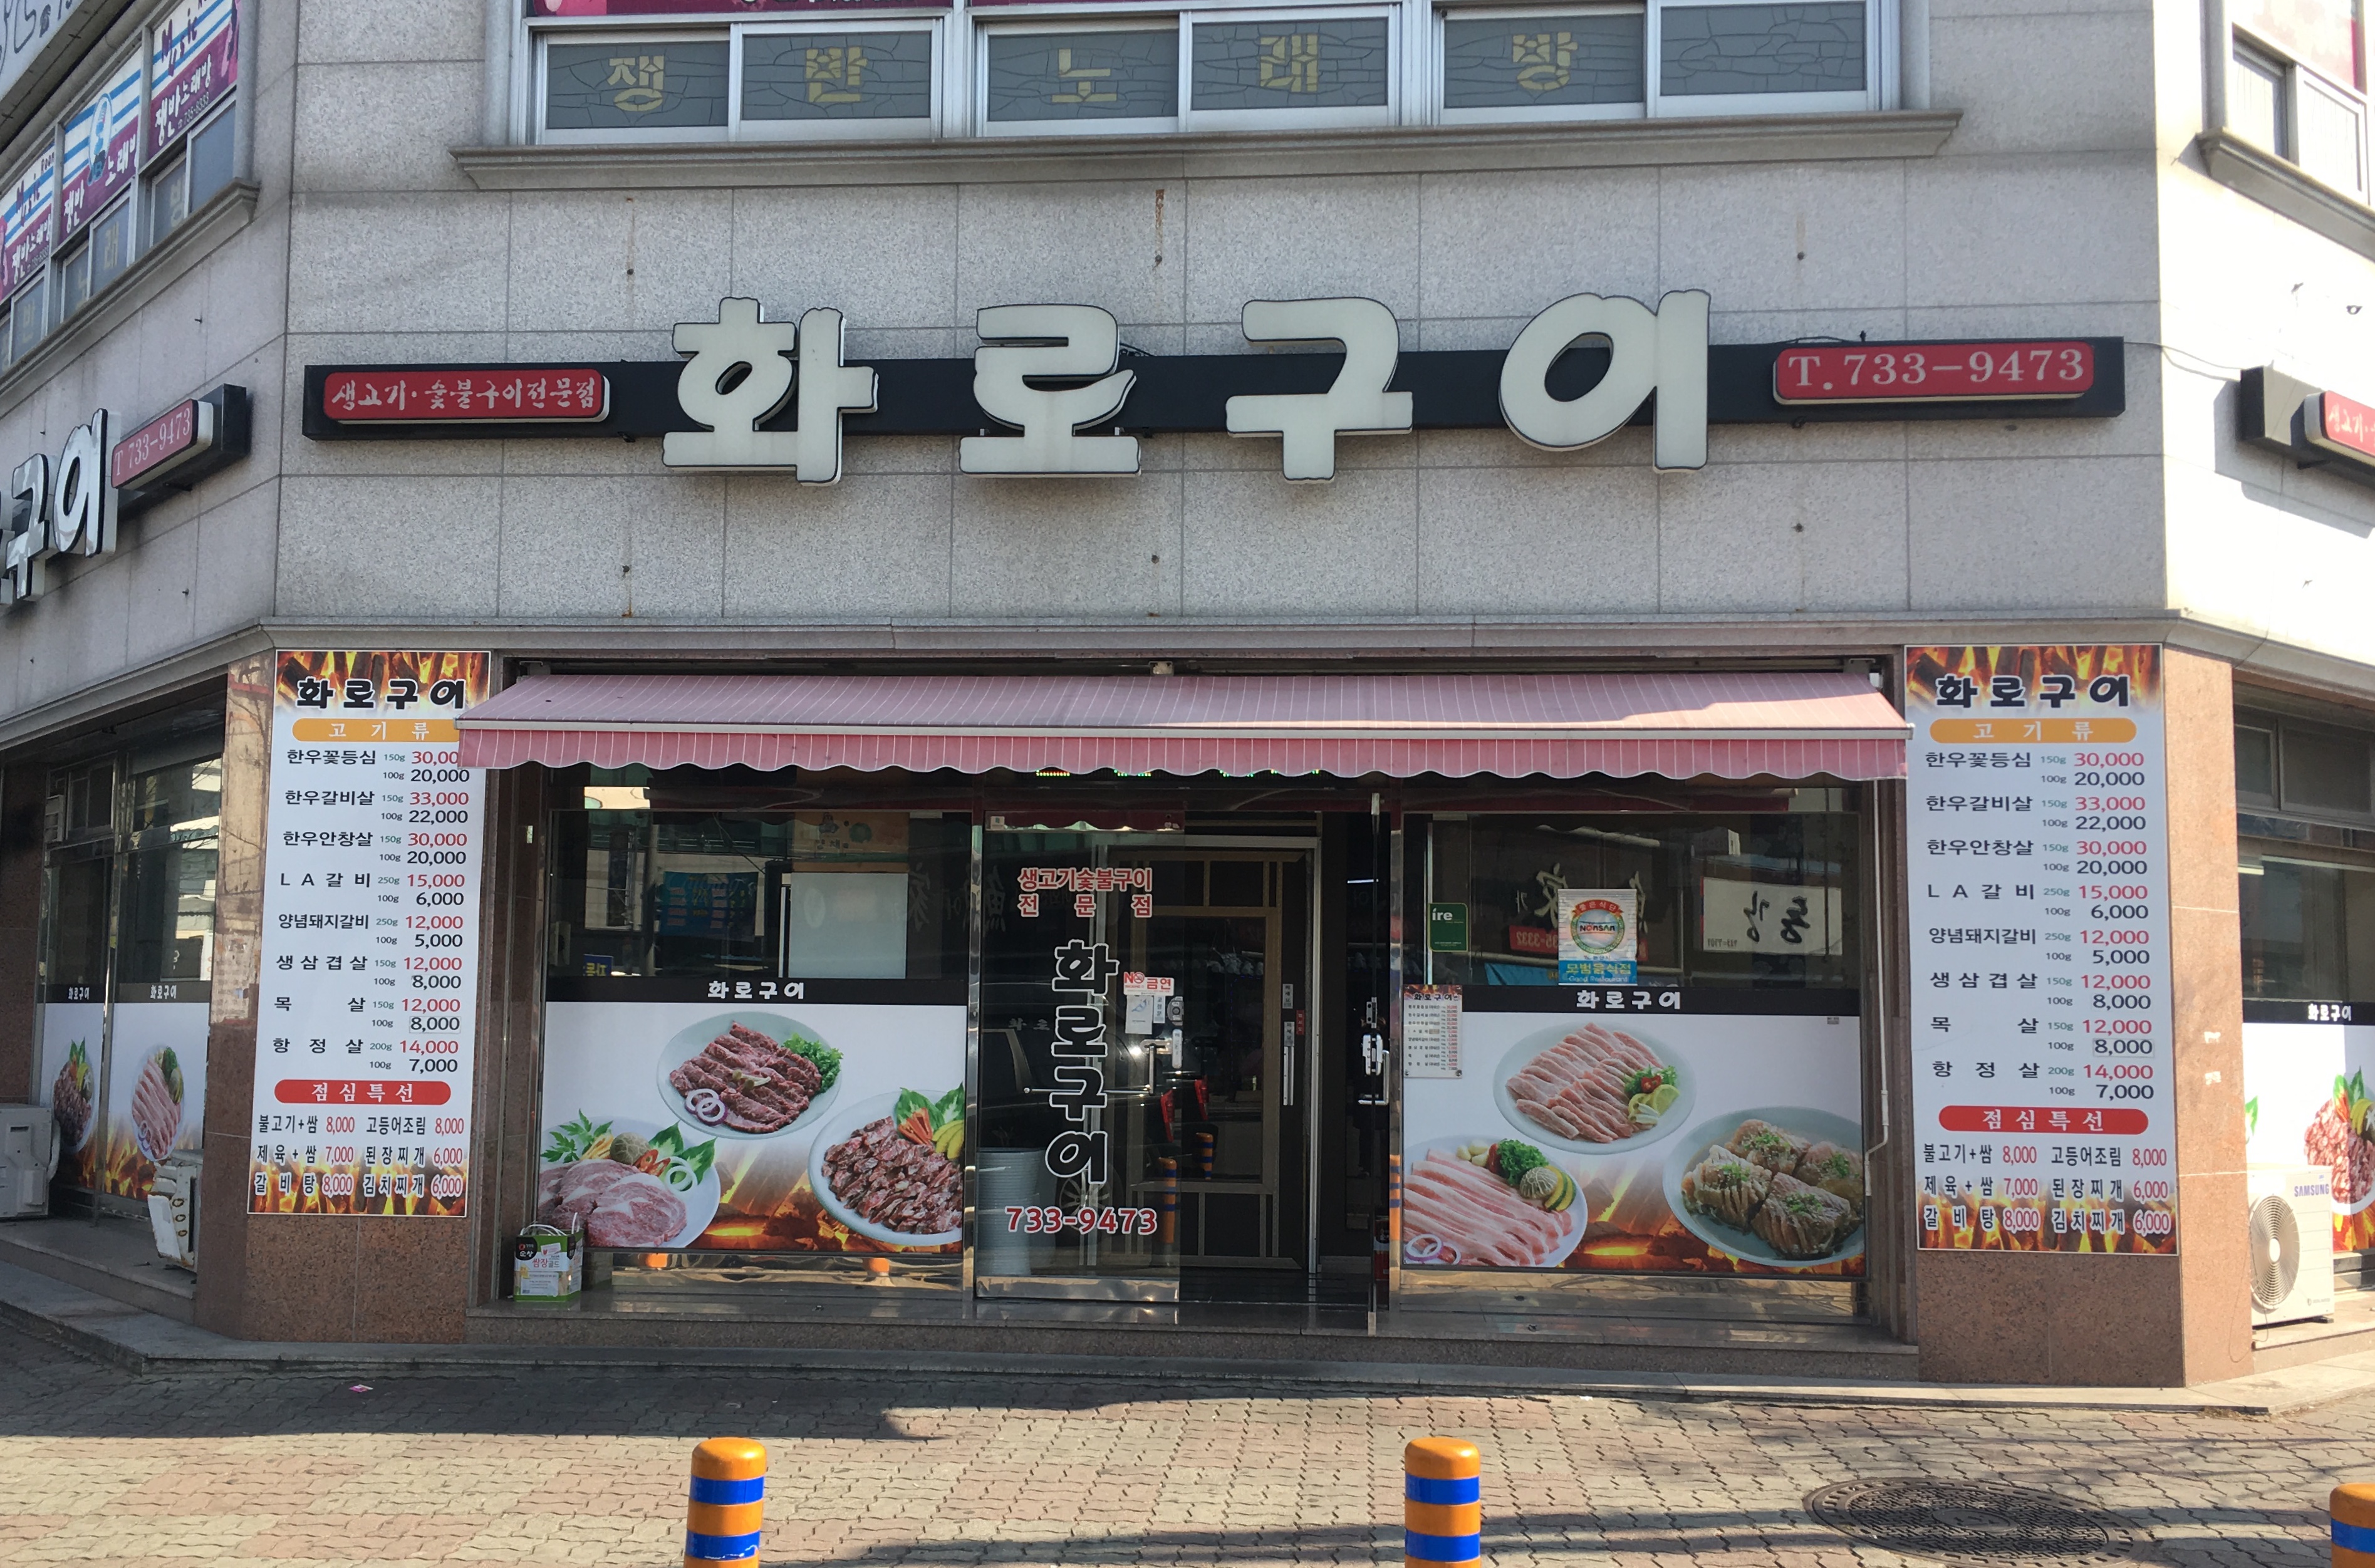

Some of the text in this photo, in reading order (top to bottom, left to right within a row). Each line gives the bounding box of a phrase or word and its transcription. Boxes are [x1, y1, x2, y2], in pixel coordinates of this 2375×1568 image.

[661, 294, 1712, 485] 화로구이
[296, 678, 465, 709] 화로구이
[1936, 676, 2129, 708] 화로구이
[288, 750, 375, 764] 한우꽃등심
[411, 751, 459, 766] 30,00
[1926, 752, 2144, 768] 한우꽃등심 150g 30,000
[383, 769, 469, 784] 100g 20,000
[2042, 772, 2144, 787] 100g 20,000
[286, 791, 375, 805] 한우갈비살
[410, 792, 469, 807] 33,000
[1926, 796, 2145, 812] 한우갈비살 150g 33,000
[409, 810, 468, 824] 22,000
[2042, 816, 2146, 832] 100g 22,000
[284, 831, 373, 846] 한우안창살
[408, 833, 467, 848] 30,000
[1927, 840, 2146, 856] 한우안창살 150g 30,000
[380, 851, 466, 866] 100g 20,000
[2044, 861, 2147, 876] 100g 20,000
[408, 875, 464, 889] 15,000
[1018, 868, 1152, 891] 생고기숯불구이
[417, 892, 464, 907] 6,000
[2044, 888, 2070, 896] 250g
[2079, 886, 2148, 901] 15,000
[2045, 905, 2148, 921] 100g 6,000
[279, 914, 463, 930] 양념돼지갈비 250g 12,000
[377, 934, 462, 948] 100g 5,000
[1930, 928, 2149, 946] 양념돼지갈비 250g 12,000
[375, 960, 396, 968] 150g
[404, 957, 462, 972] 12,000
[2047, 950, 2149, 965] 100g 5,000
[1566, 963, 1631, 975] 모범음식점
[375, 975, 461, 990] 100g 8,000
[708, 980, 805, 1000] 화로구이
[1147, 978, 1171, 990] 금연
[2047, 978, 2072, 986] 150g
[2082, 975, 2150, 990] 12,000
[150, 985, 177, 1000] 화로구이
[1576, 989, 1681, 1010] 화로구이
[402, 999, 460, 1014] 12,000
[2047, 994, 2151, 1010] 100g 8,000
[2308, 1003, 2351, 1022] 화로구이
[411, 1017, 459, 1032] 8,000
[2048, 1022, 2073, 1031] 150g
[2083, 1020, 2151, 1036] 12,000
[370, 1043, 392, 1051] 200g
[400, 1041, 458, 1055] 14,000
[2049, 1039, 2152, 1056] 100g 8,000
[409, 1059, 457, 1074] 7,000
[2049, 1067, 2074, 1076] 200g
[2084, 1065, 2153, 1081] 14,000
[2050, 1085, 2154, 1101] 100g 7,000
[326, 1116, 355, 1134] 8,000
[366, 1116, 425, 1135] 고등어조림
[435, 1118, 464, 1136] 8,000
[326, 1146, 353, 1165] 7,000
[434, 1148, 462, 1166] 6,000
[2003, 1146, 2037, 1165] 8,000
[2052, 1146, 2121, 1166] 고등어조림
[2133, 1148, 2166, 1168] 8,000
[323, 1176, 352, 1195] 8,000
[431, 1178, 461, 1196] 6,000
[2003, 1178, 2038, 1197] 7,000
[2133, 1180, 2168, 1200] 6,000
[2294, 1184, 2329, 1197] SAMSUNG
[1006, 1207, 1158, 1235] 733-9473
[2004, 1210, 2039, 1230] 8,000
[2135, 1213, 2169, 1233] 6,000
